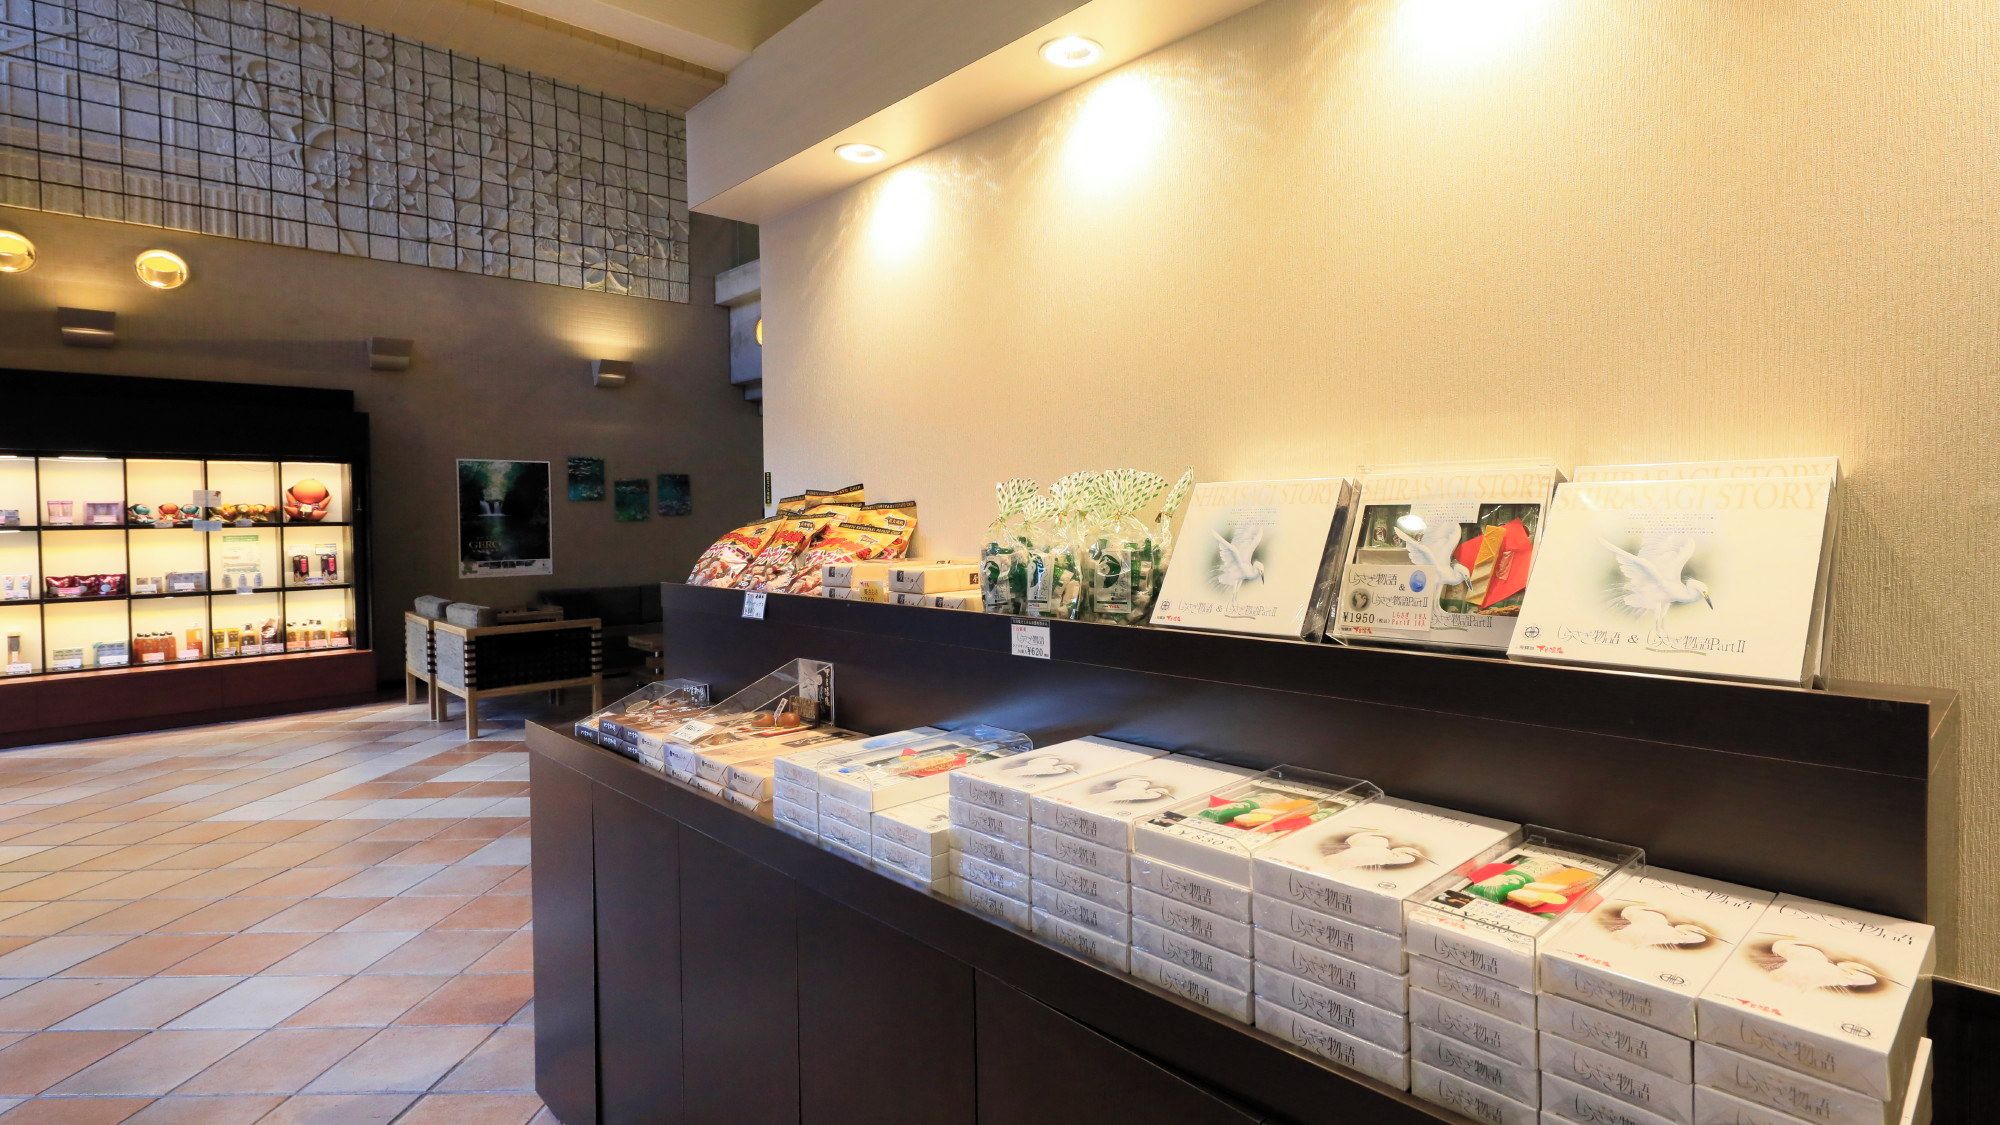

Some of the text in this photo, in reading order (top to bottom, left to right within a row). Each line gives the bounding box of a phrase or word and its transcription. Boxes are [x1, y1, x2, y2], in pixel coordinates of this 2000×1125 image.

[1280, 483, 1334, 504] STORY
[1715, 481, 1824, 511] STORY
[1342, 612, 1375, 625] ¥1950
[1628, 634, 1639, 644] &
[1288, 873, 1352, 914] しらさぎ物語
[1290, 909, 1354, 952] しらさぎ物語
[1292, 945, 1357, 990] しらさぎ物語
[1434, 933, 1498, 974] しらさぎ物語
[1291, 981, 1355, 1028] しらさぎ物語
[1291, 1017, 1355, 1066] しらさぎ物語
[1571, 1011, 1649, 1059] しらさぎ物語
[1572, 1052, 1650, 1102] しらさぎ物語
